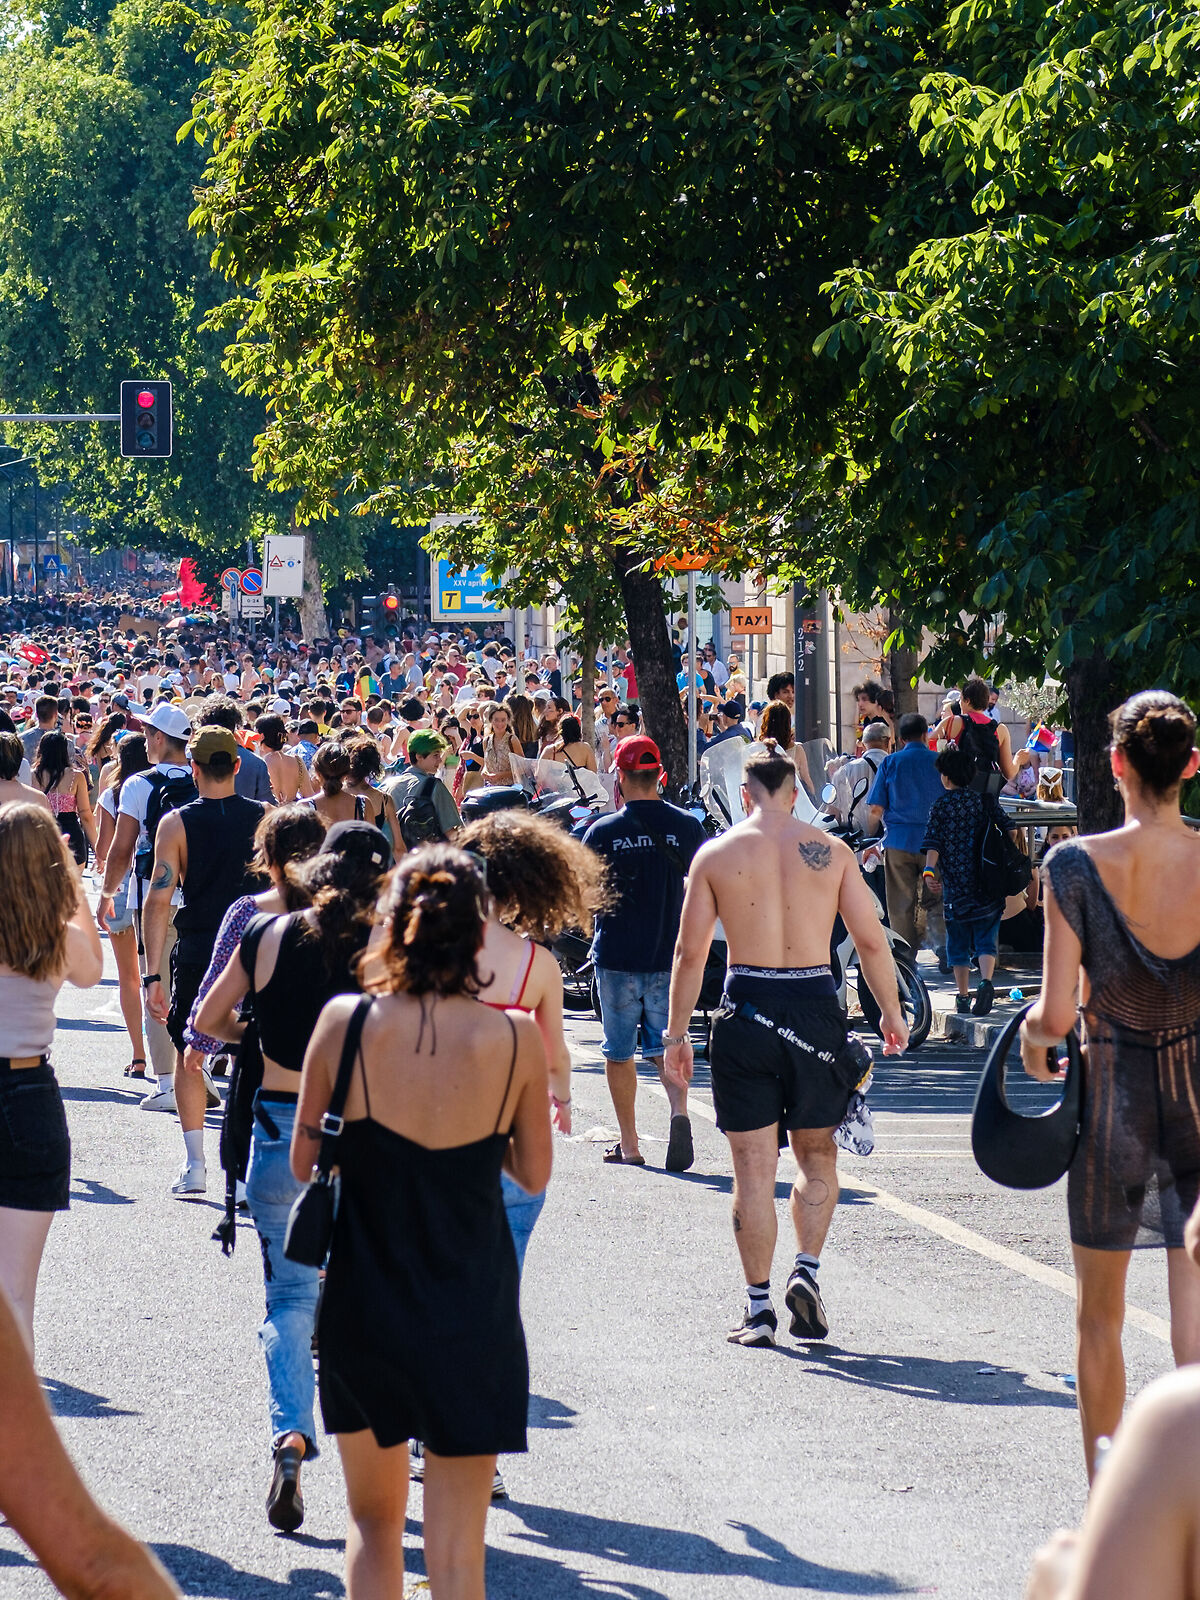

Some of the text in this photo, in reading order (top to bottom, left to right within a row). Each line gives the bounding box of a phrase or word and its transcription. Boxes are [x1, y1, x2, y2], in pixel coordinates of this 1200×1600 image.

[453, 579, 467, 587] XXV
[445, 592, 458, 608] T
[735, 615, 768, 626] TAXI
[777, 1027, 815, 1053] ellesse
